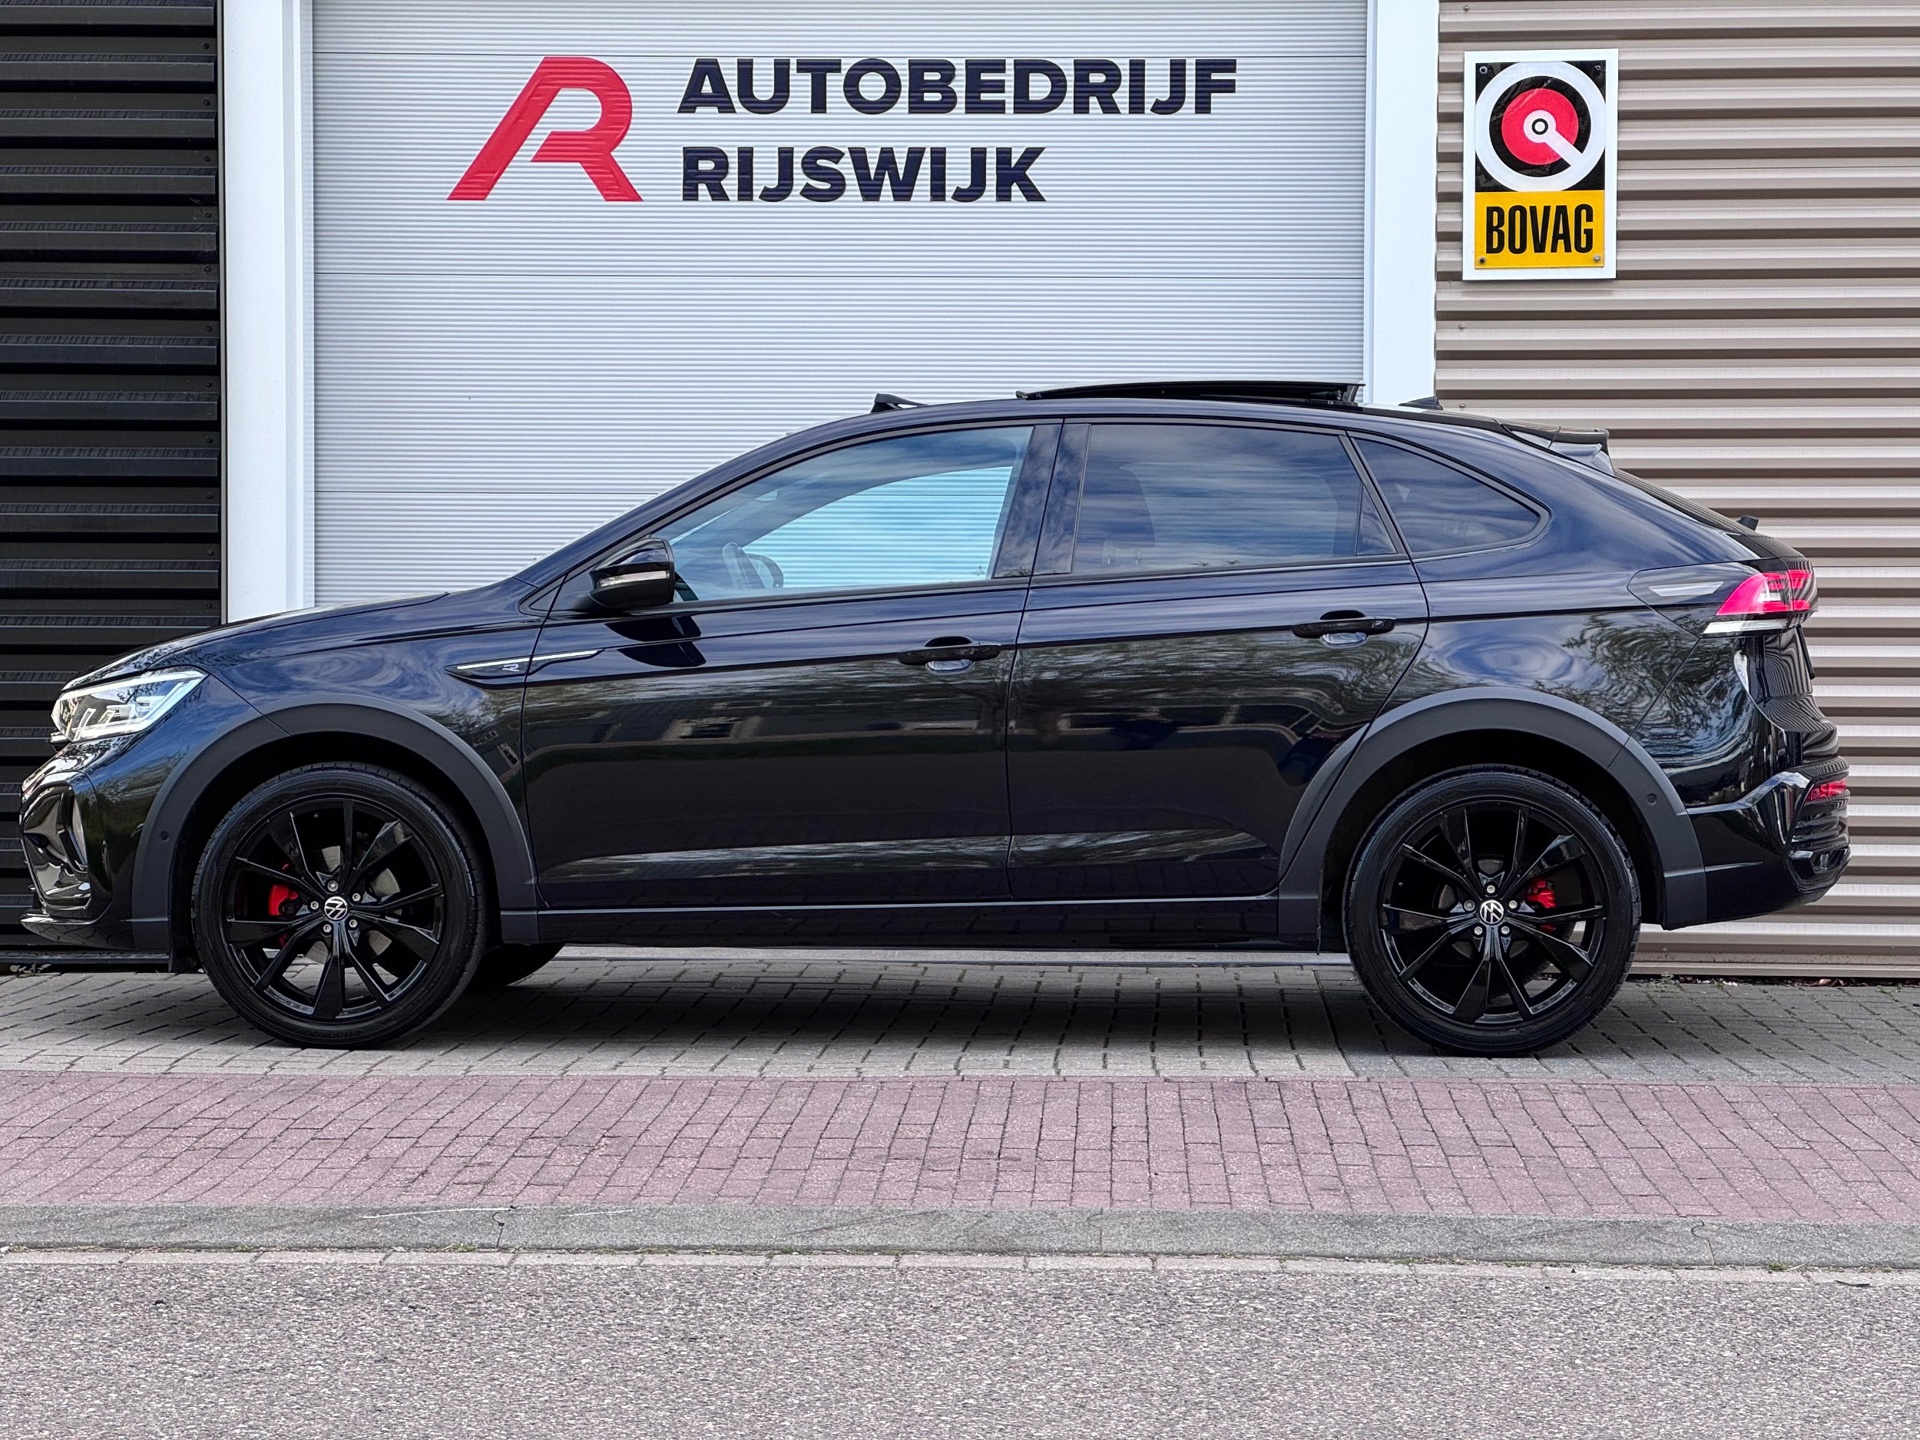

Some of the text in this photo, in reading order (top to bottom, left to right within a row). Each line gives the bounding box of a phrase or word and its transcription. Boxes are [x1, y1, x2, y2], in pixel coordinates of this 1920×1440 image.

[677, 58, 1237, 115] AUTOBEDRIJF
[681, 145, 1047, 203] RIJSWIJK
[1485, 203, 1594, 255] BOVAG
